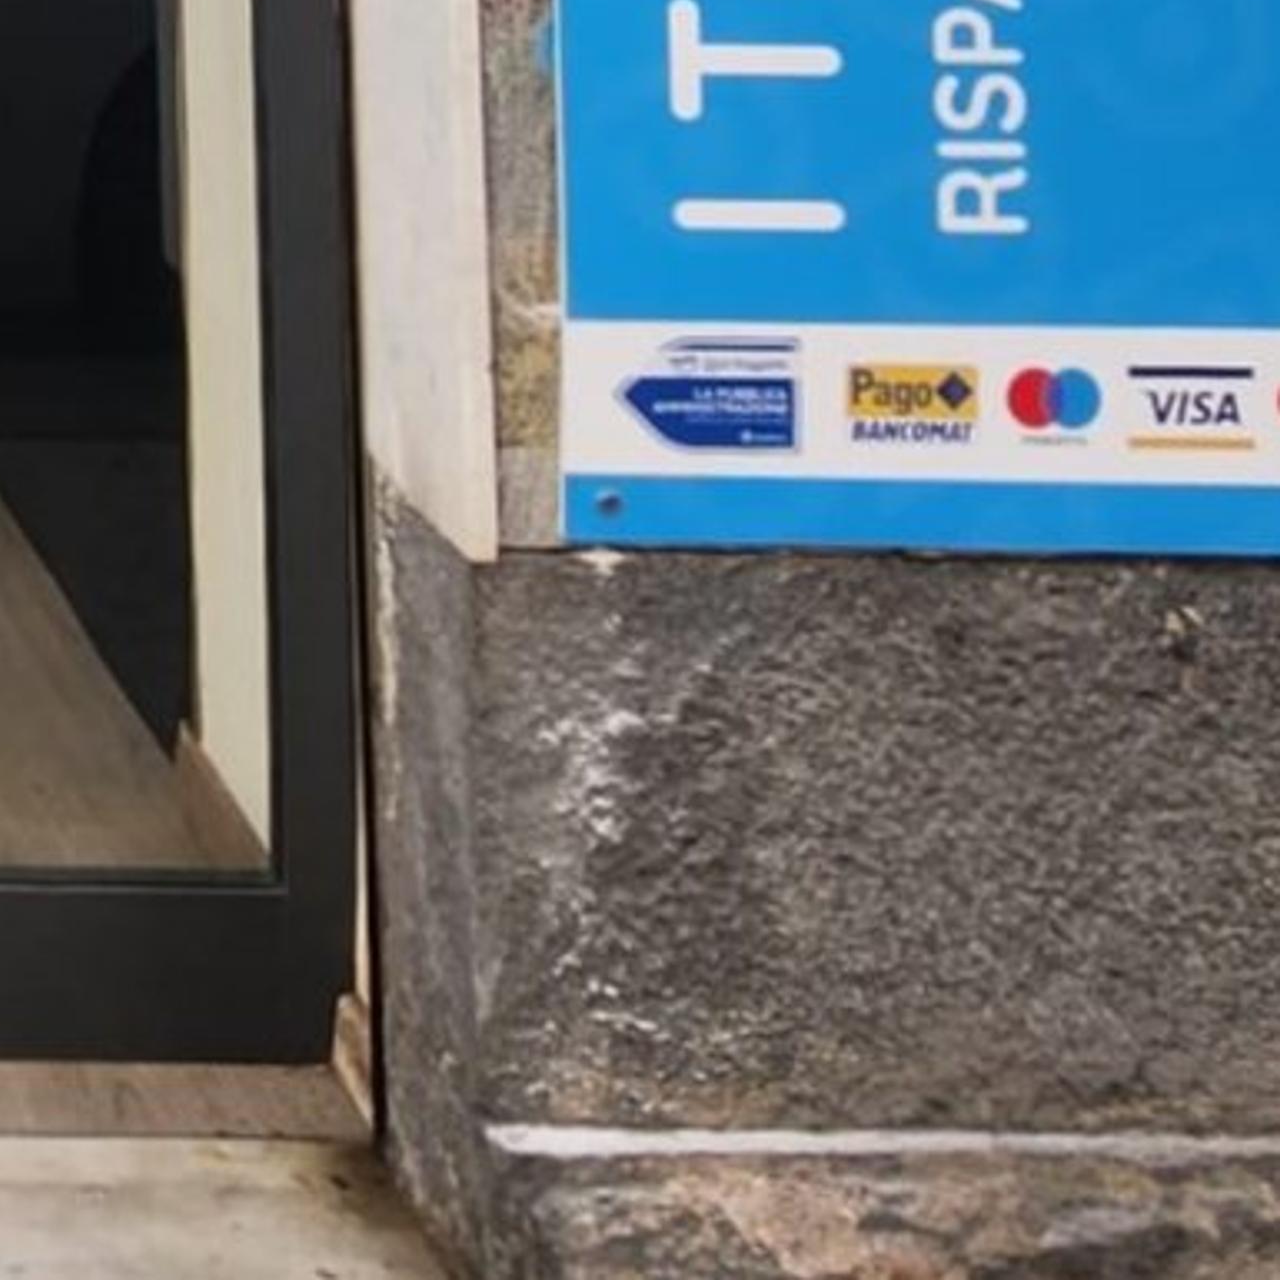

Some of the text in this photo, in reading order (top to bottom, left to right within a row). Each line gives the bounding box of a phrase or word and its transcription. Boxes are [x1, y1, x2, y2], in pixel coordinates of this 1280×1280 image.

[671, 198, 847, 232] I
[850, 368, 933, 417] Pago
[1148, 390, 1242, 426] VISA
